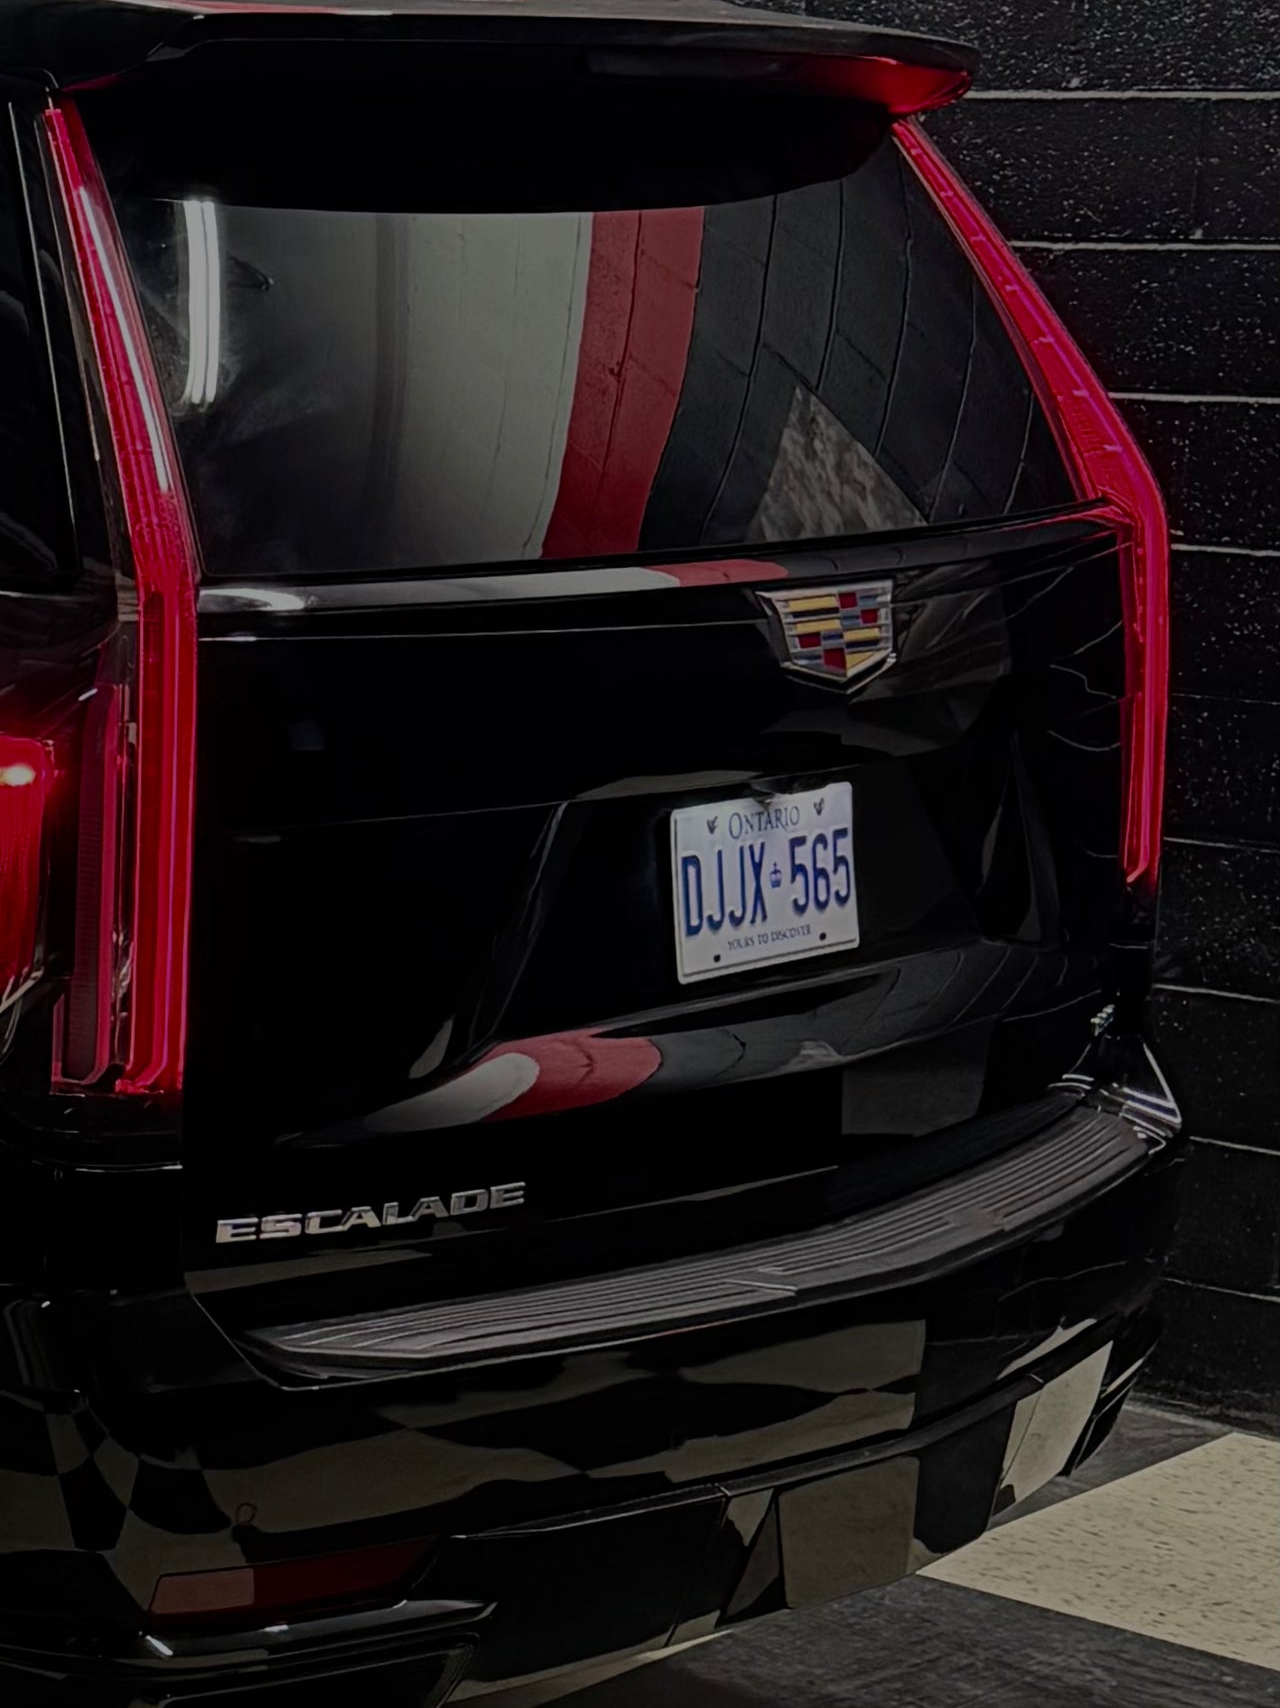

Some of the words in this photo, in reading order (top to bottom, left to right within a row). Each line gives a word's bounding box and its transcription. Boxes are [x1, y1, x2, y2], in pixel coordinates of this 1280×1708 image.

[728, 805, 801, 839] ONTARIO
[681, 841, 768, 938] DJJX
[788, 827, 852, 916] 565
[215, 1181, 526, 1244] ESCALADE
